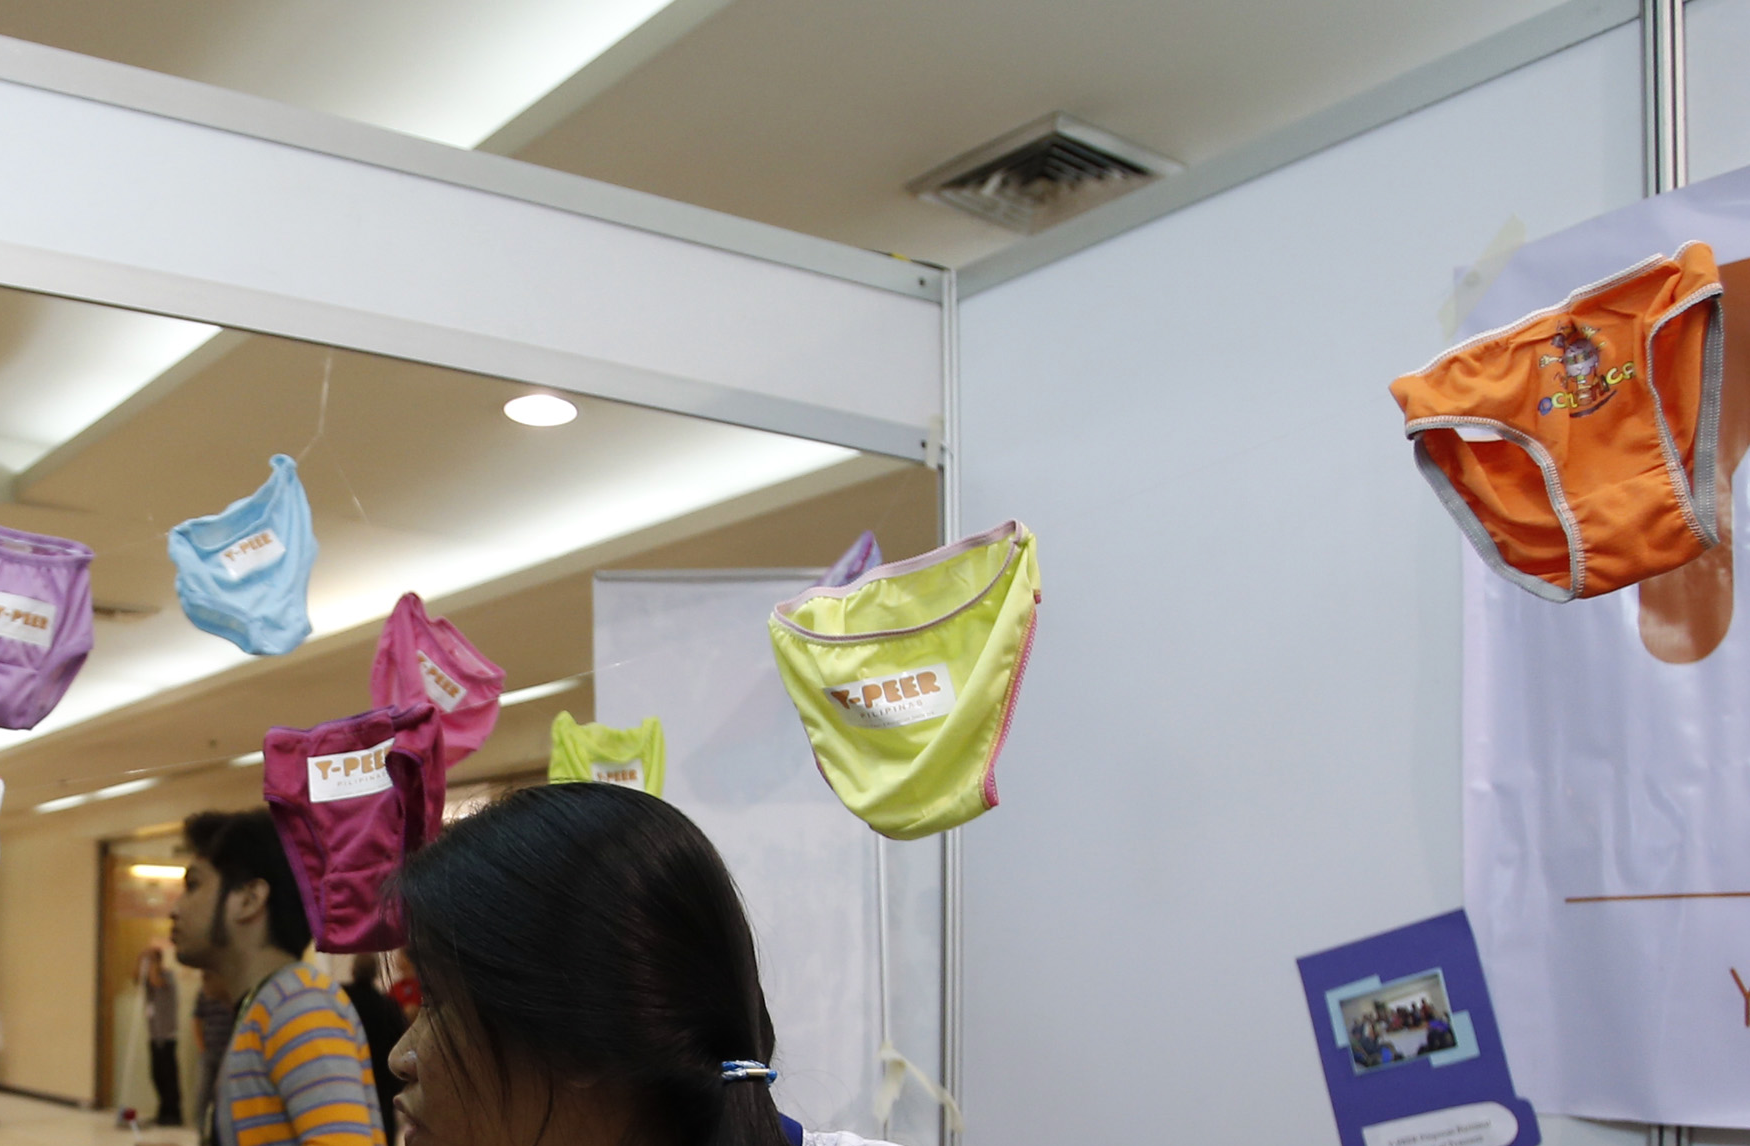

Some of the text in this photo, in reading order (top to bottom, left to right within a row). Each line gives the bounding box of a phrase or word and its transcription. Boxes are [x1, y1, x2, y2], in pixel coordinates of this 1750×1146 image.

[224, 532, 273, 562] Y-PEER
[830, 671, 941, 710] Y-PEER
[859, 700, 924, 719] PILIPINAS
[315, 746, 391, 780] Y-PEE
